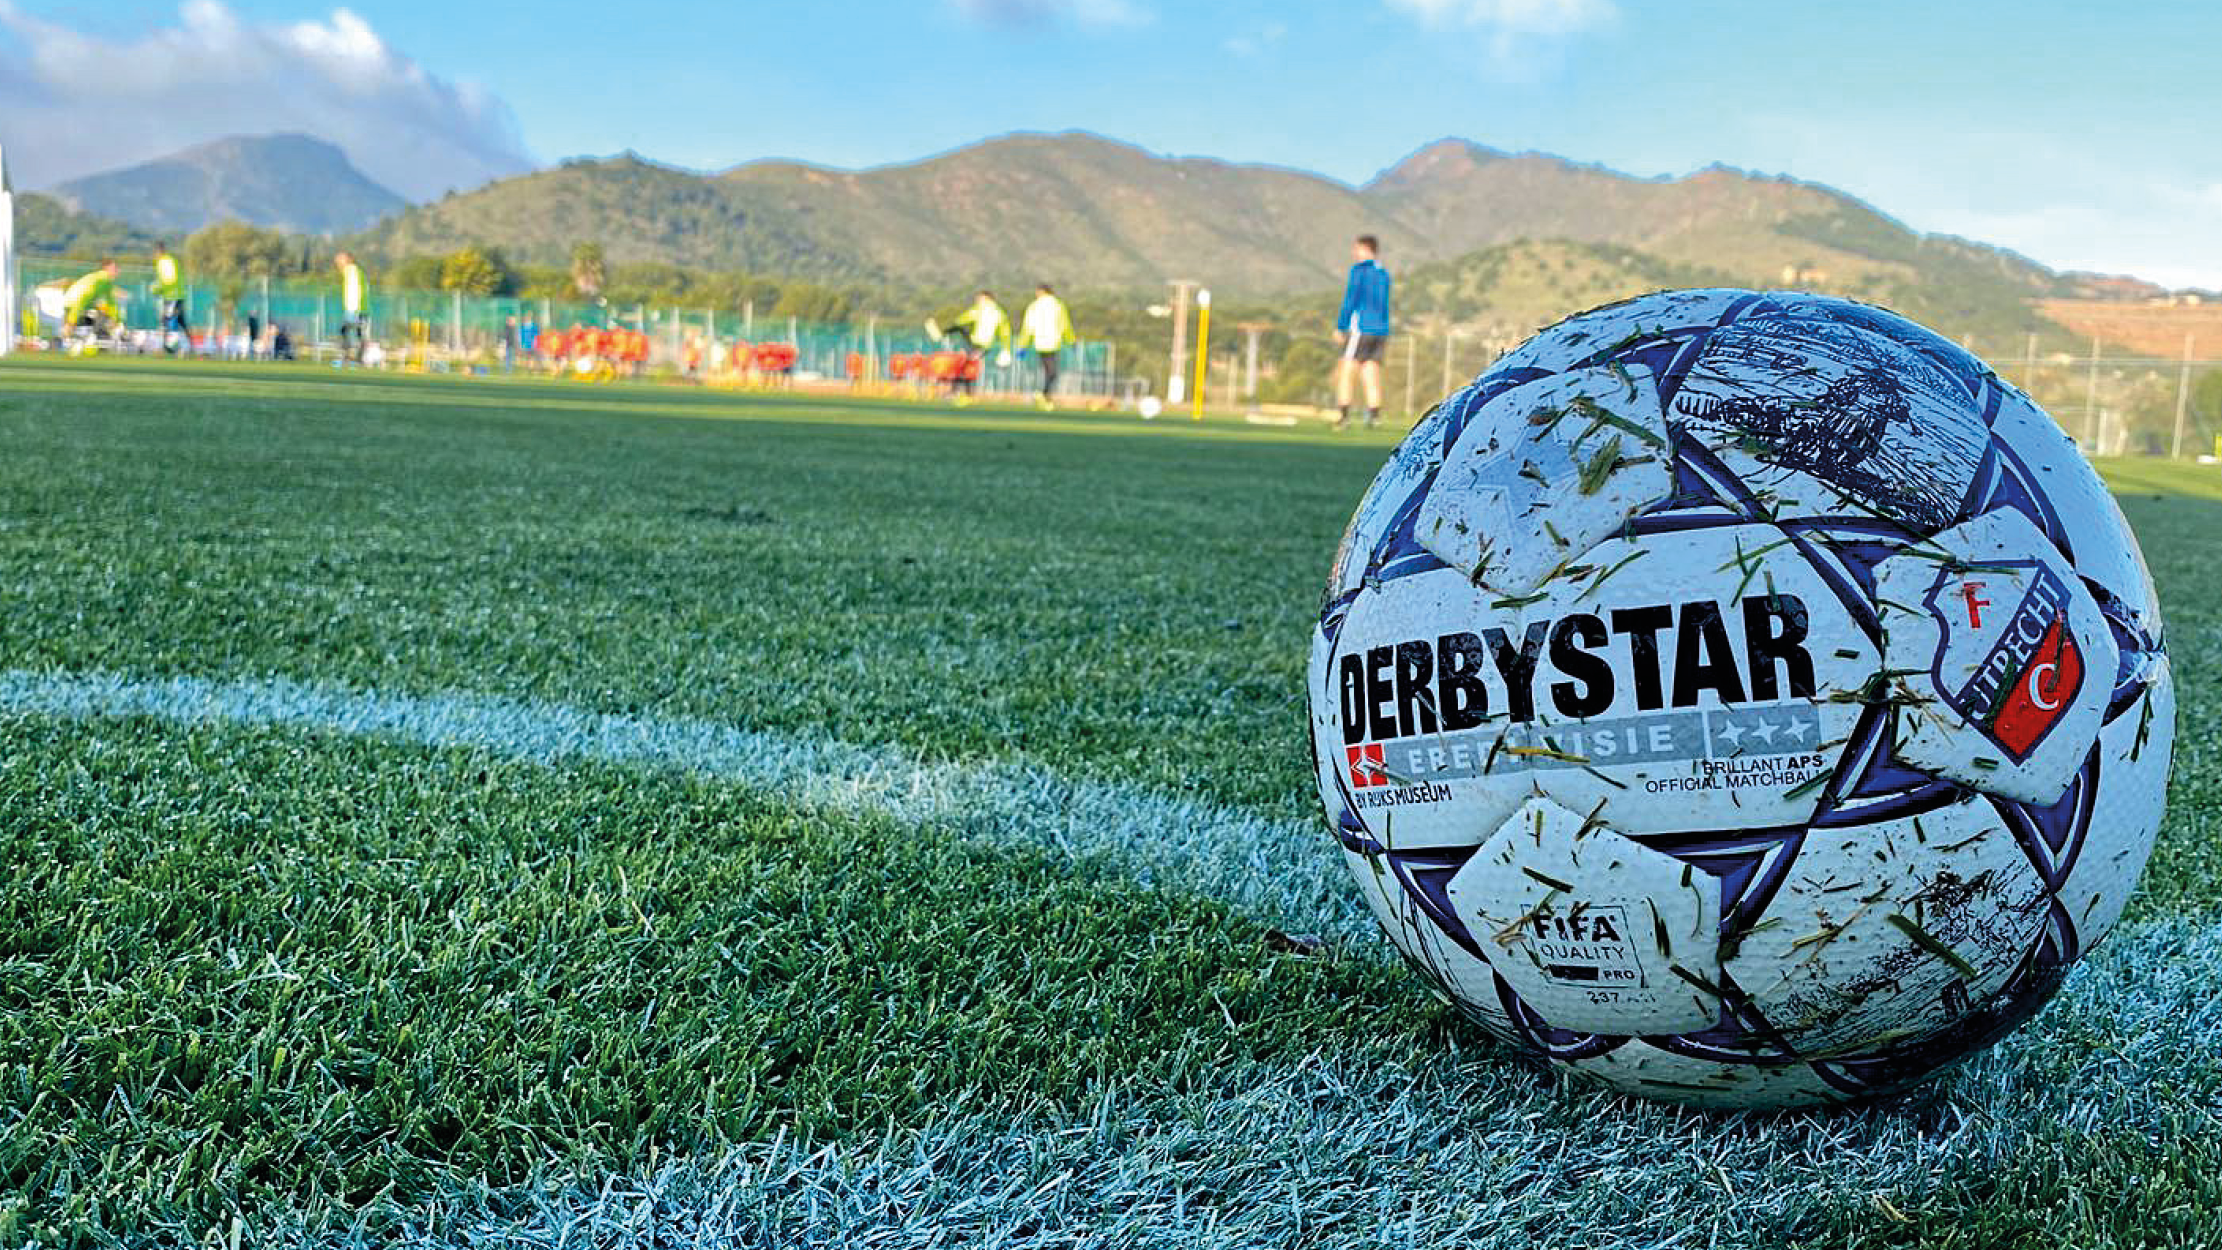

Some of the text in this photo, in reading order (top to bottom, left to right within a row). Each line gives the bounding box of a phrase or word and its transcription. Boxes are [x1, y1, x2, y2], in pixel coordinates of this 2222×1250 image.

[1963, 581, 1991, 630] F
[1340, 594, 1817, 745] DERBYSTAR
[2029, 663, 2060, 710] C
[1703, 754, 1823, 776] BRILLANT APS
[1646, 776, 1722, 794] OFFICIAL
[1532, 914, 1621, 942] FIFA
[1540, 943, 1625, 960] QUALITY
[1603, 970, 1635, 980] PRO
